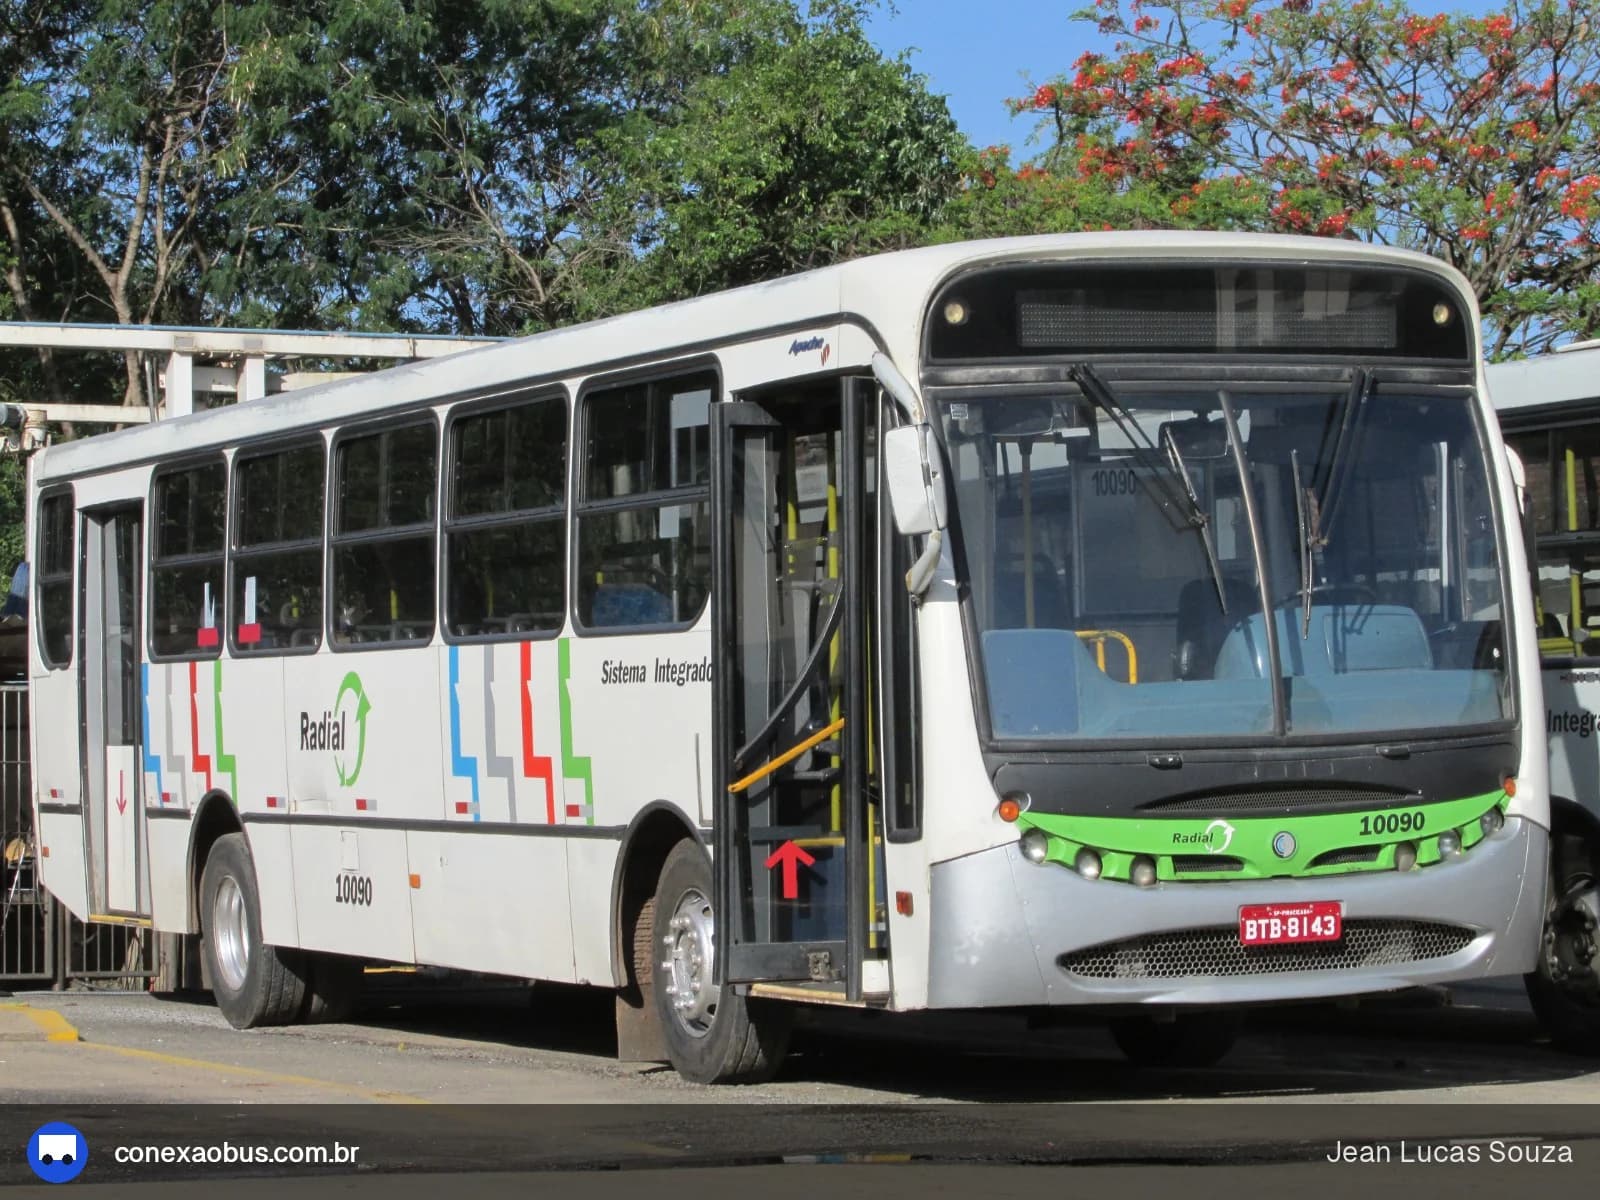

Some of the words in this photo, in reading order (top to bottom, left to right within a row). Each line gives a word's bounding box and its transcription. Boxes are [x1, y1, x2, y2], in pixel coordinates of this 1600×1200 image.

[1091, 469, 1136, 497] 10090
[600, 659, 647, 685] Sistema
[300, 710, 346, 751] Radial
[1359, 811, 1426, 836] 10090
[1172, 831, 1214, 844] Radial
[335, 873, 373, 907] 10090
